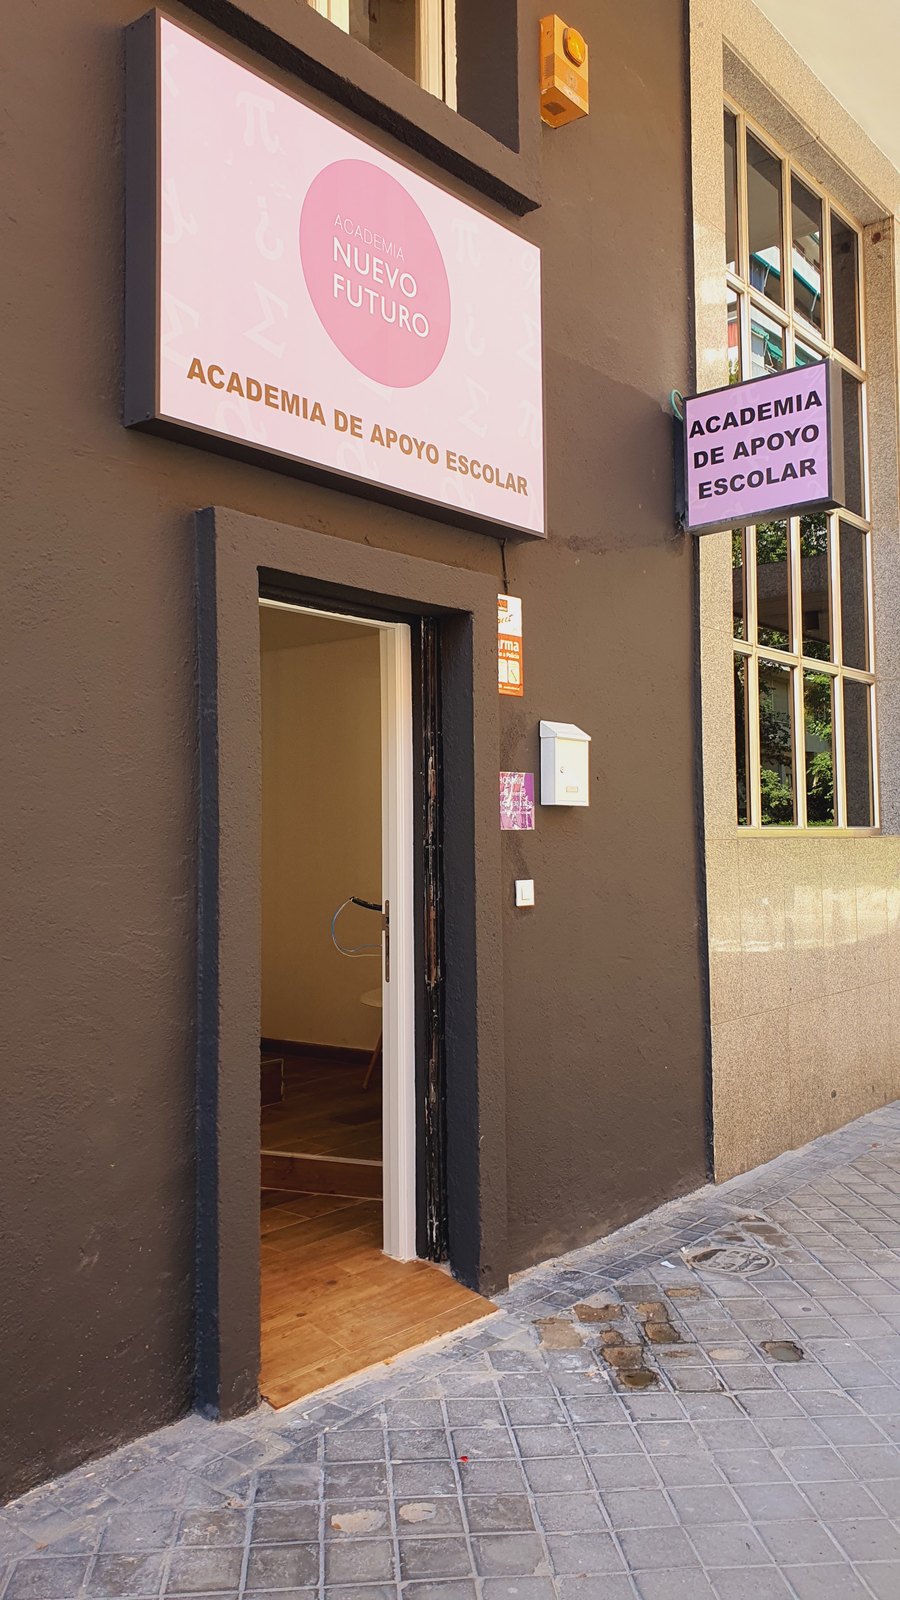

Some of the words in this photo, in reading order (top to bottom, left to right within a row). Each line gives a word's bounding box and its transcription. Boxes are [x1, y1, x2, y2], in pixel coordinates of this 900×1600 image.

[334, 214, 405, 262] ACADEMIA
[333, 236, 417, 298] NUEVO
[333, 273, 430, 338] FUTURO
[187, 357, 326, 426] ACADEMIA
[334, 408, 363, 439] DE
[370, 423, 440, 465] APOYO
[446, 449, 528, 496] ESCOLAR
[689, 390, 822, 439] ACADEMIA
[693, 446, 725, 469] DE
[732, 424, 820, 460] APOYO
[698, 458, 817, 500] ESCOLAR
